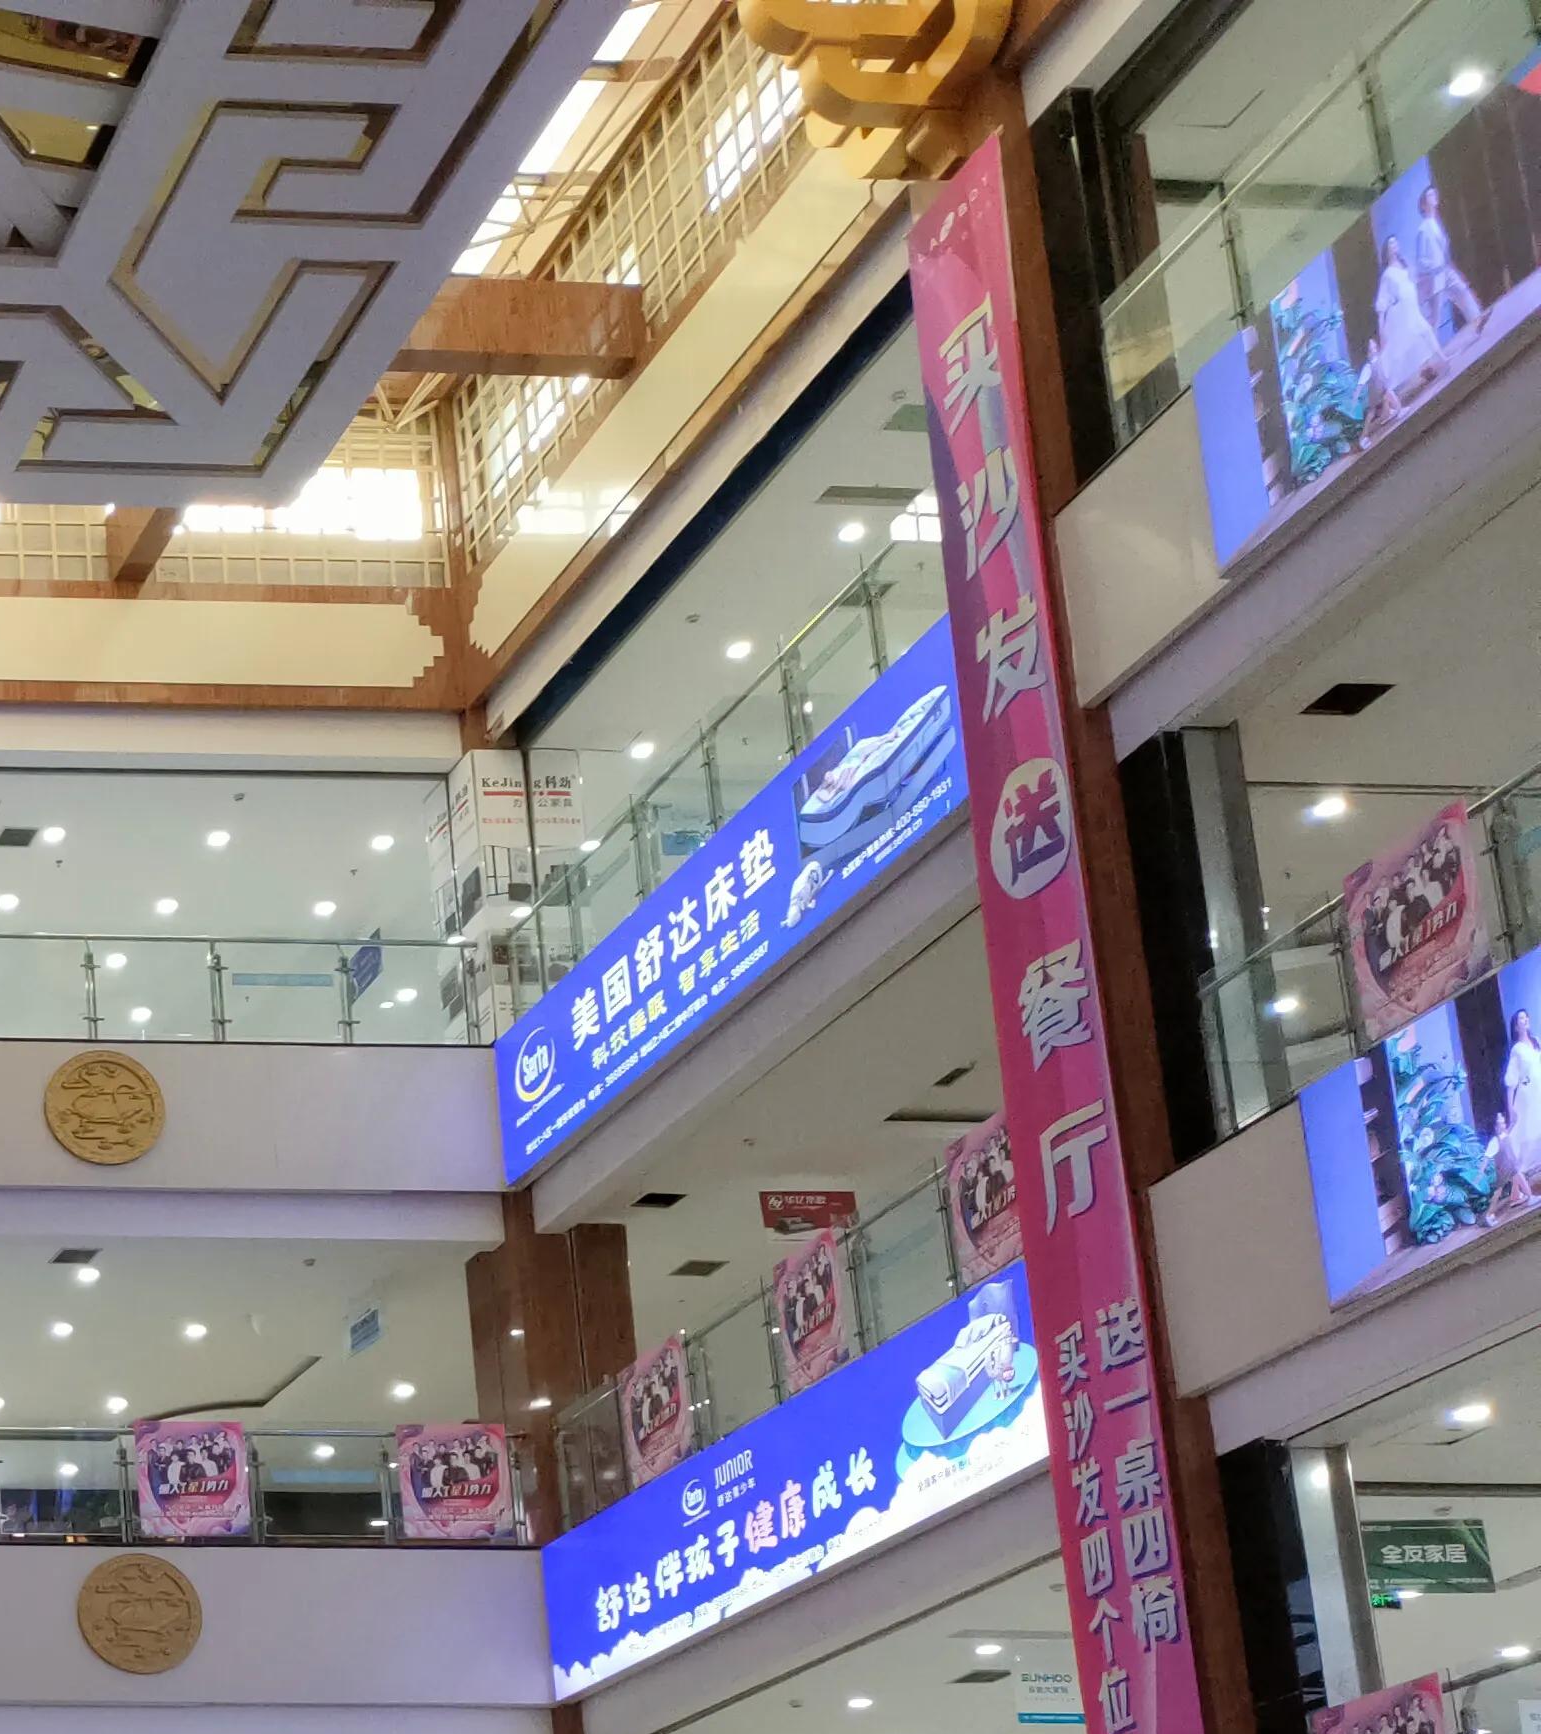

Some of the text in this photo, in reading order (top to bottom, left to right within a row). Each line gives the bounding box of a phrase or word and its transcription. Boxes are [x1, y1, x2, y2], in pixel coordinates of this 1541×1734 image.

[570, 828, 777, 1051] 美国舒达床垫
[591, 999, 668, 1070] 科技睡眠
[678, 910, 762, 996] 智享生活
[521, 1038, 550, 1087] Serta
[595, 1446, 878, 1633] 舒达伴孩子健康成长
[714, 1448, 754, 1490] JUNIOR
[1095, 1298, 1181, 1654] 送一桌四椅
